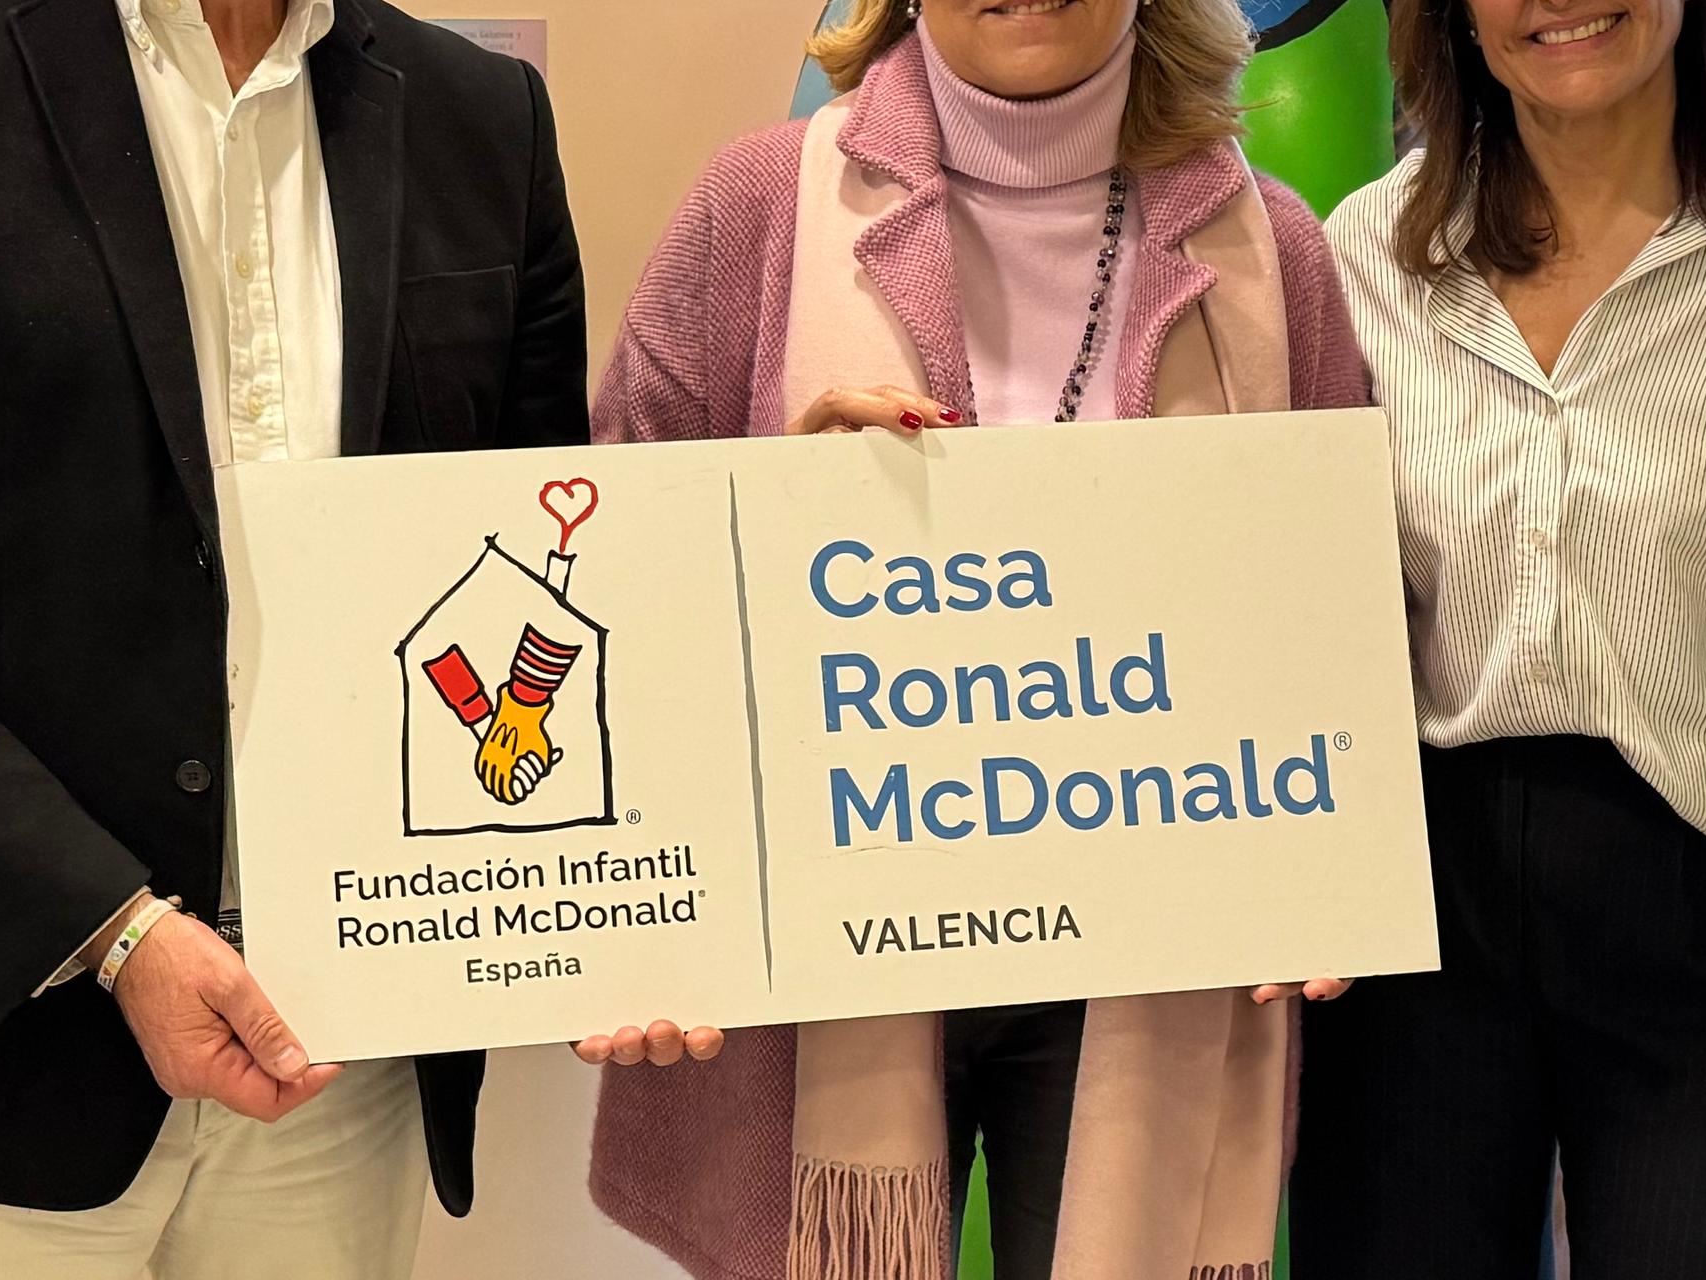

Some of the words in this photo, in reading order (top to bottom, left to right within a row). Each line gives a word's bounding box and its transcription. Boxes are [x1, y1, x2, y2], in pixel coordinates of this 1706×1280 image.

[809, 540, 1052, 619] Casa
[820, 633, 1172, 733] Ronald
[334, 858, 545, 902] Fundación
[559, 845, 697, 886] Infantil
[337, 906, 481, 948] Ronald
[842, 904, 1082, 956] VALENCIA
[466, 952, 583, 987] España
